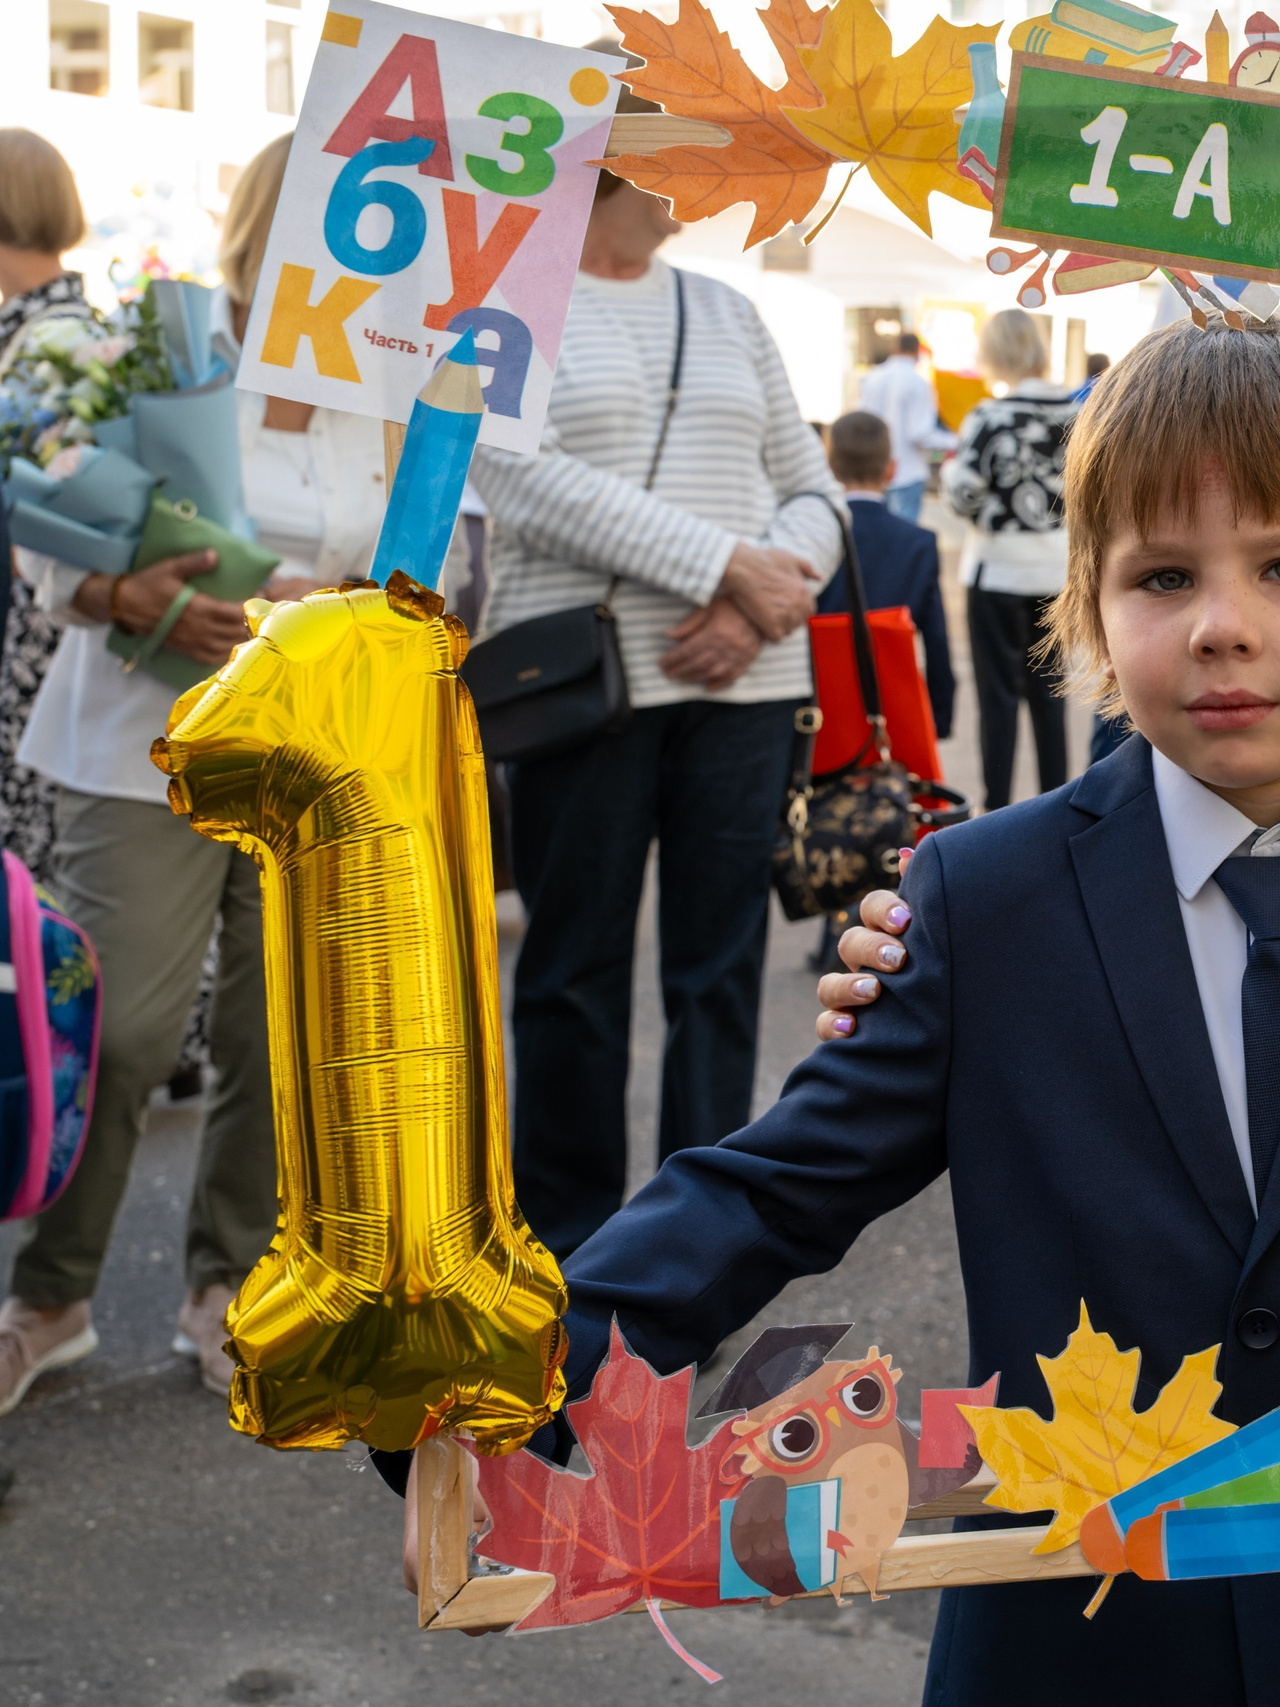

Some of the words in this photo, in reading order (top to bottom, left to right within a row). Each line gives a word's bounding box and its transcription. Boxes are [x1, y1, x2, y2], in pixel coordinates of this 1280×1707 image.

[1069, 105, 1232, 227] 1-А
[364, 328, 418, 354] Часть
[425, 343, 434, 358] 1
